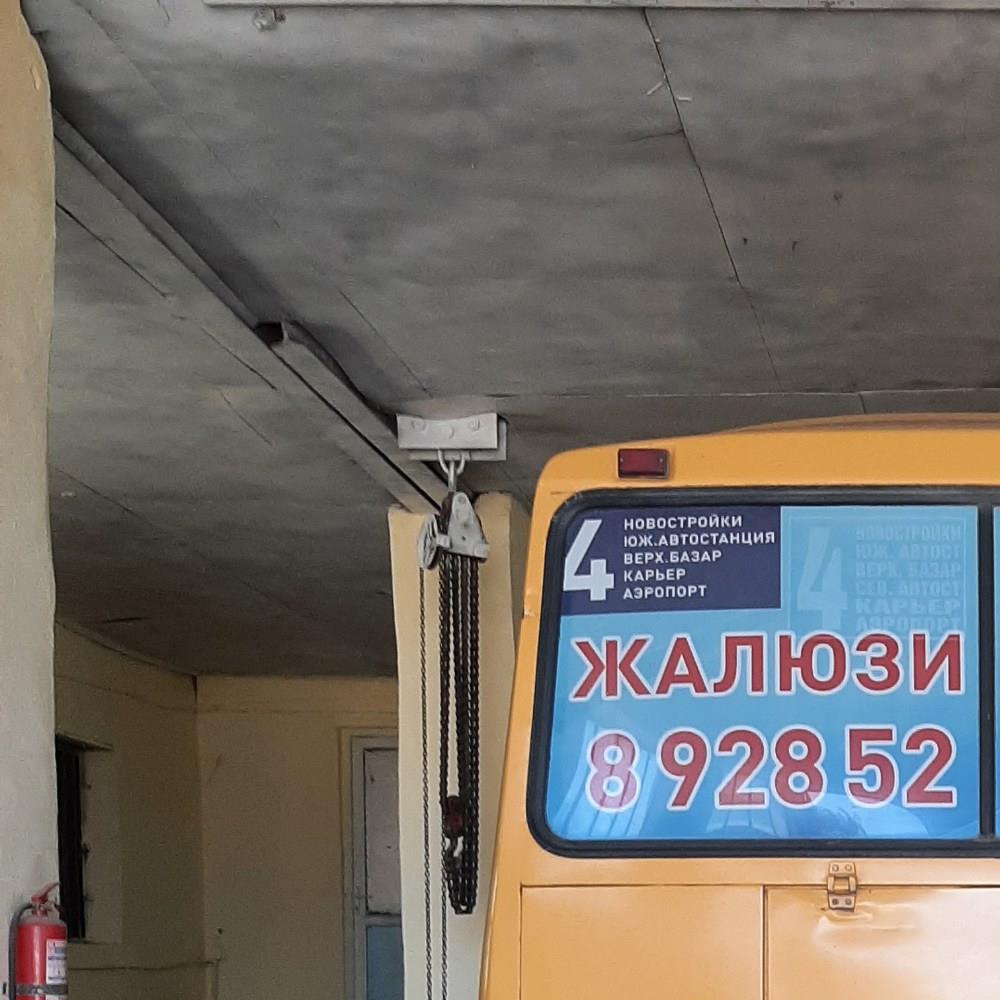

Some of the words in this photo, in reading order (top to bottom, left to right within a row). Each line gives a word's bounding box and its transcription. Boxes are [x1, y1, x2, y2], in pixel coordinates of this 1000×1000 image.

[624, 514, 742, 530] НОВОСТРОЙКИ
[624, 531, 775, 547] ЮЖ.АВТОСТАНЦИЯ
[563, 519, 614, 601] 4
[624, 550, 722, 565] ВЕРХ.БАЗАР
[624, 568, 686, 582] КАРЬЕР
[797, 527, 848, 630] 4
[623, 585, 707, 599] АЭРОПОРТ
[569, 630, 966, 702] ЖАЛЮЗИ
